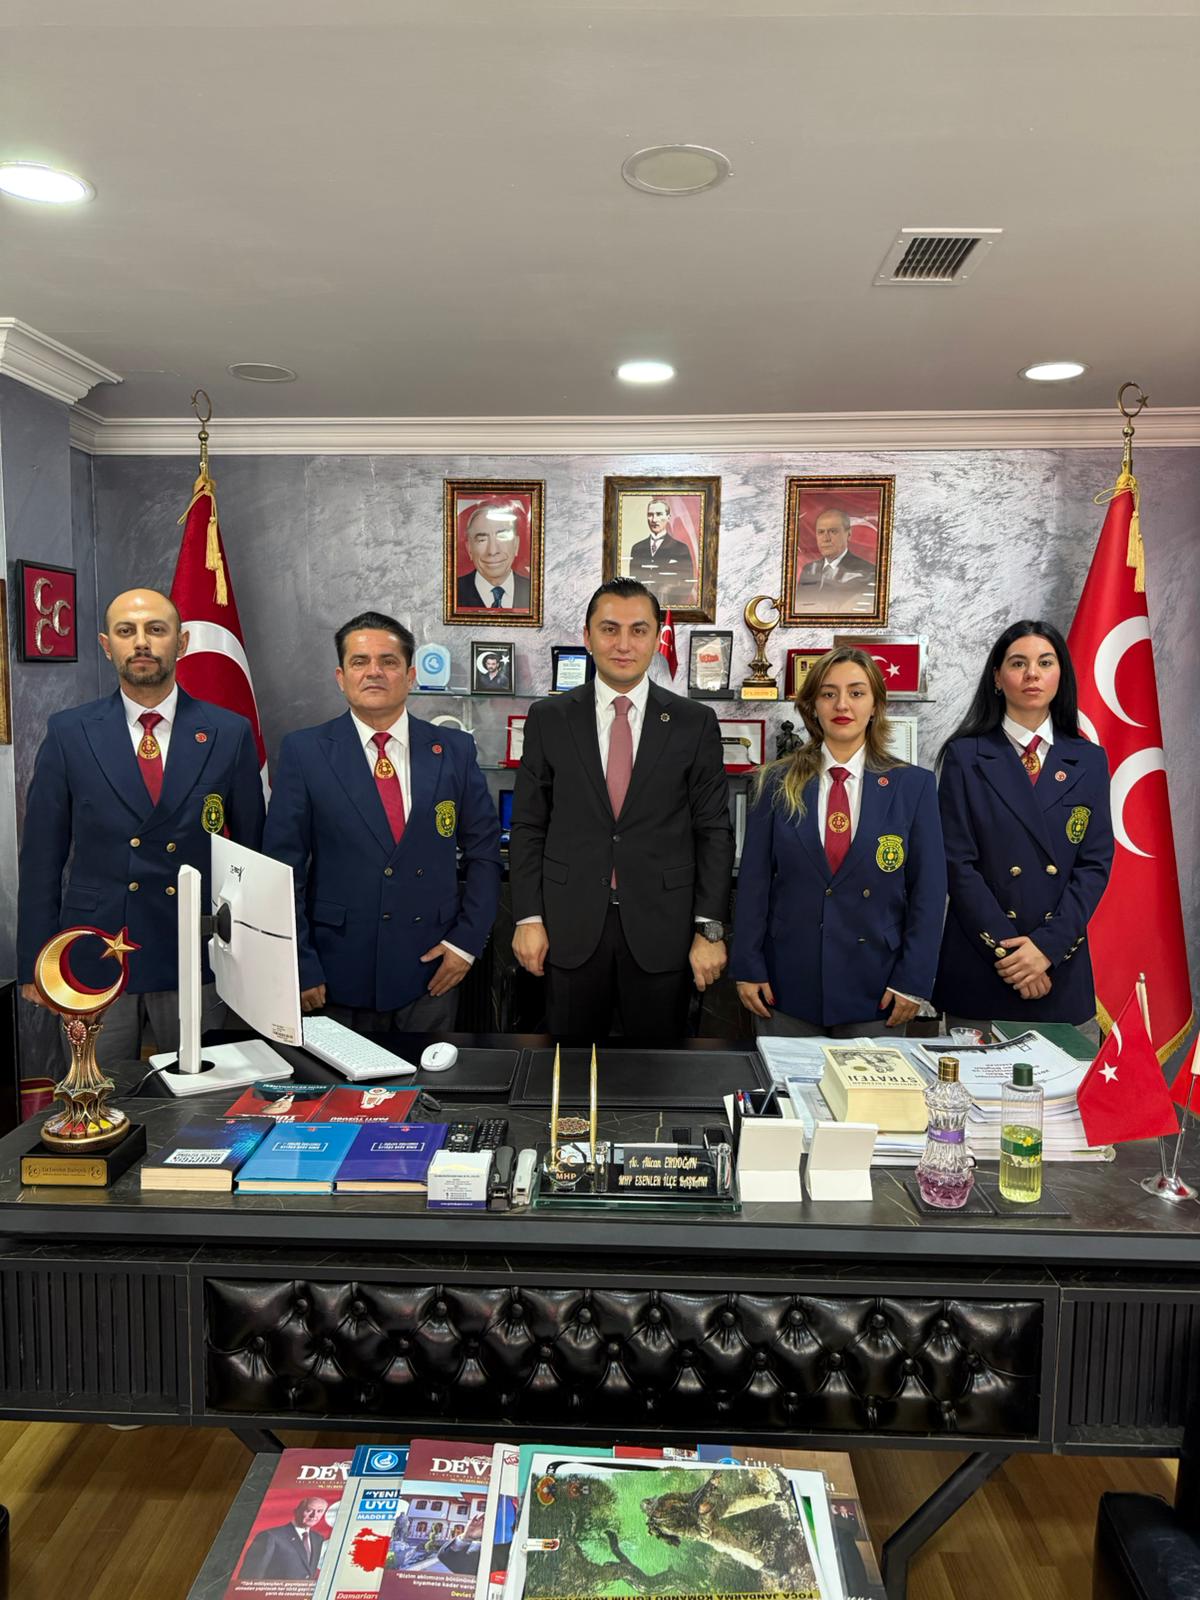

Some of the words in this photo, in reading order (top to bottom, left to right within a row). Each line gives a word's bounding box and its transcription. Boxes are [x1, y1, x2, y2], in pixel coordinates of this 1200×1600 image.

[635, 1175, 661, 1187] ESENLER
[663, 1173, 678, 1189] İLÇE
[430, 1458, 492, 1477] DEV
